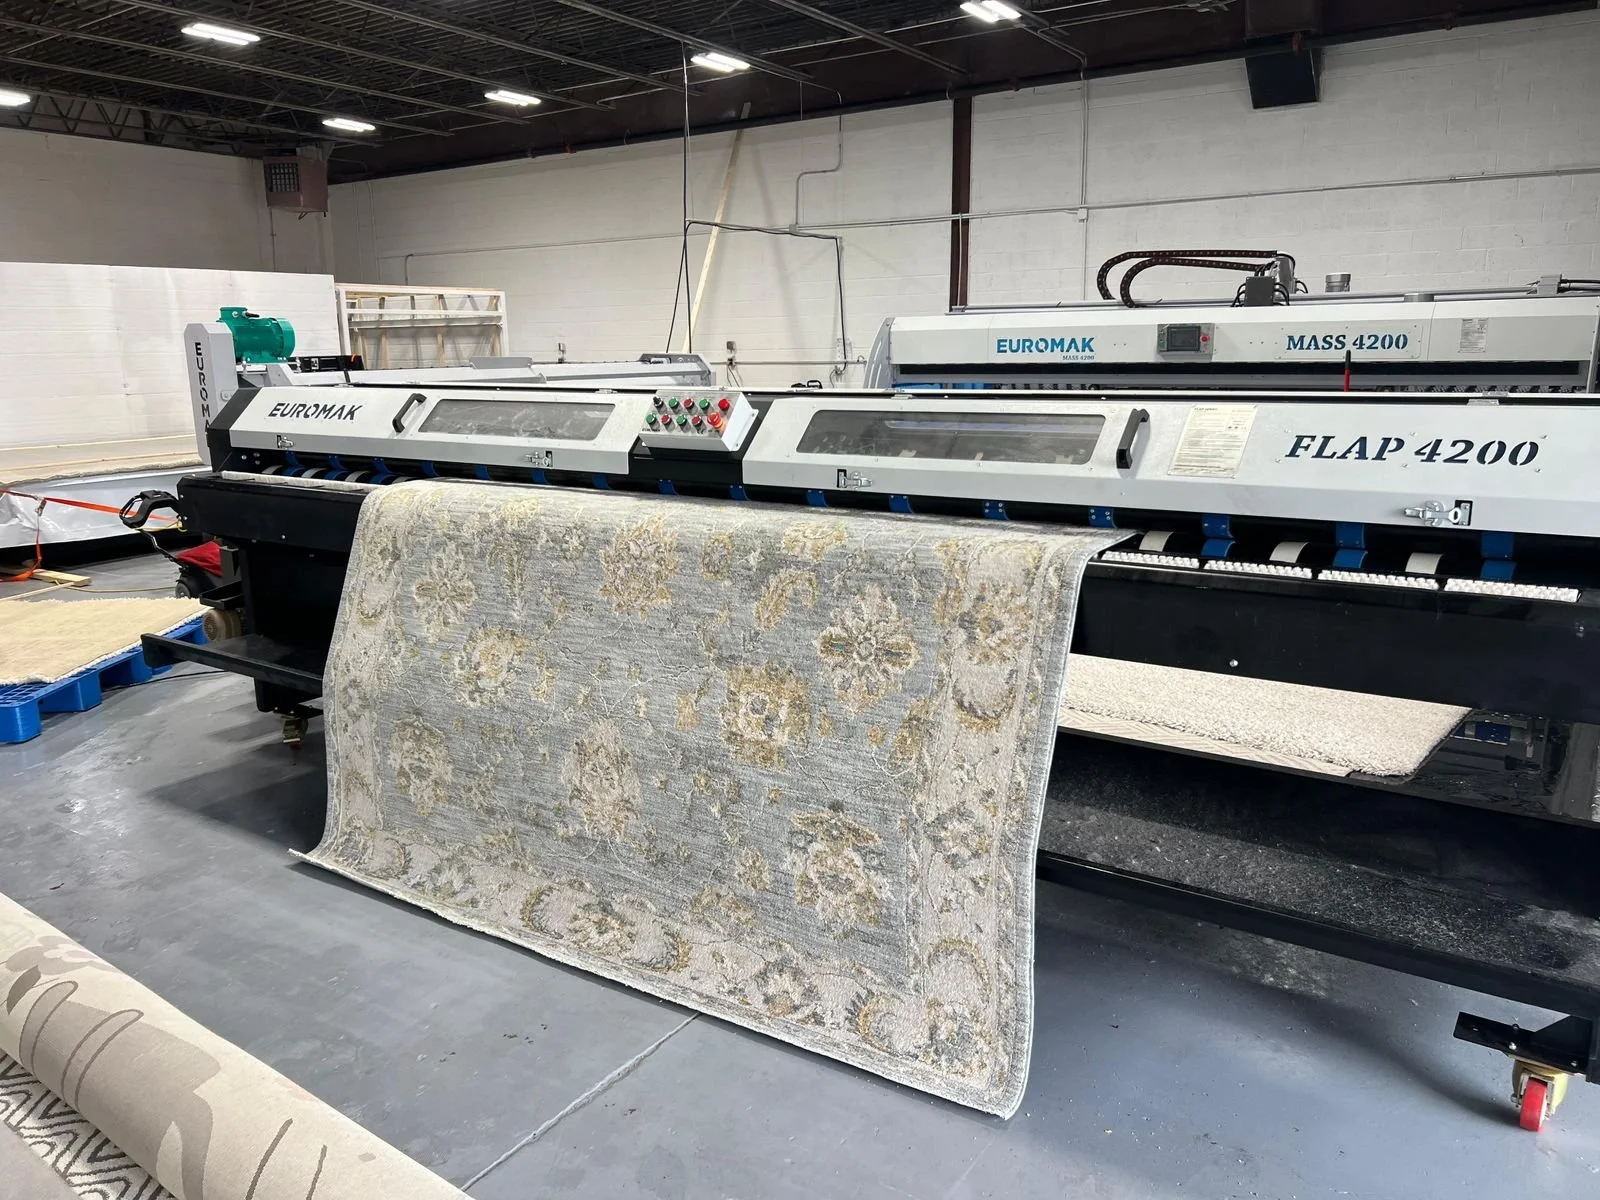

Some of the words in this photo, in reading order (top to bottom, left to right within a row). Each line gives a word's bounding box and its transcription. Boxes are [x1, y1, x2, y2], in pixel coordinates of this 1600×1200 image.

[997, 337, 1095, 353] EUROMAK
[1286, 335, 1347, 351] MASS
[1352, 334, 1409, 350] 4200
[194, 342, 211, 447] EUROMA
[267, 402, 364, 421] EUROMAK
[1284, 435, 1405, 461] FLAP
[1414, 438, 1540, 466] 4200
